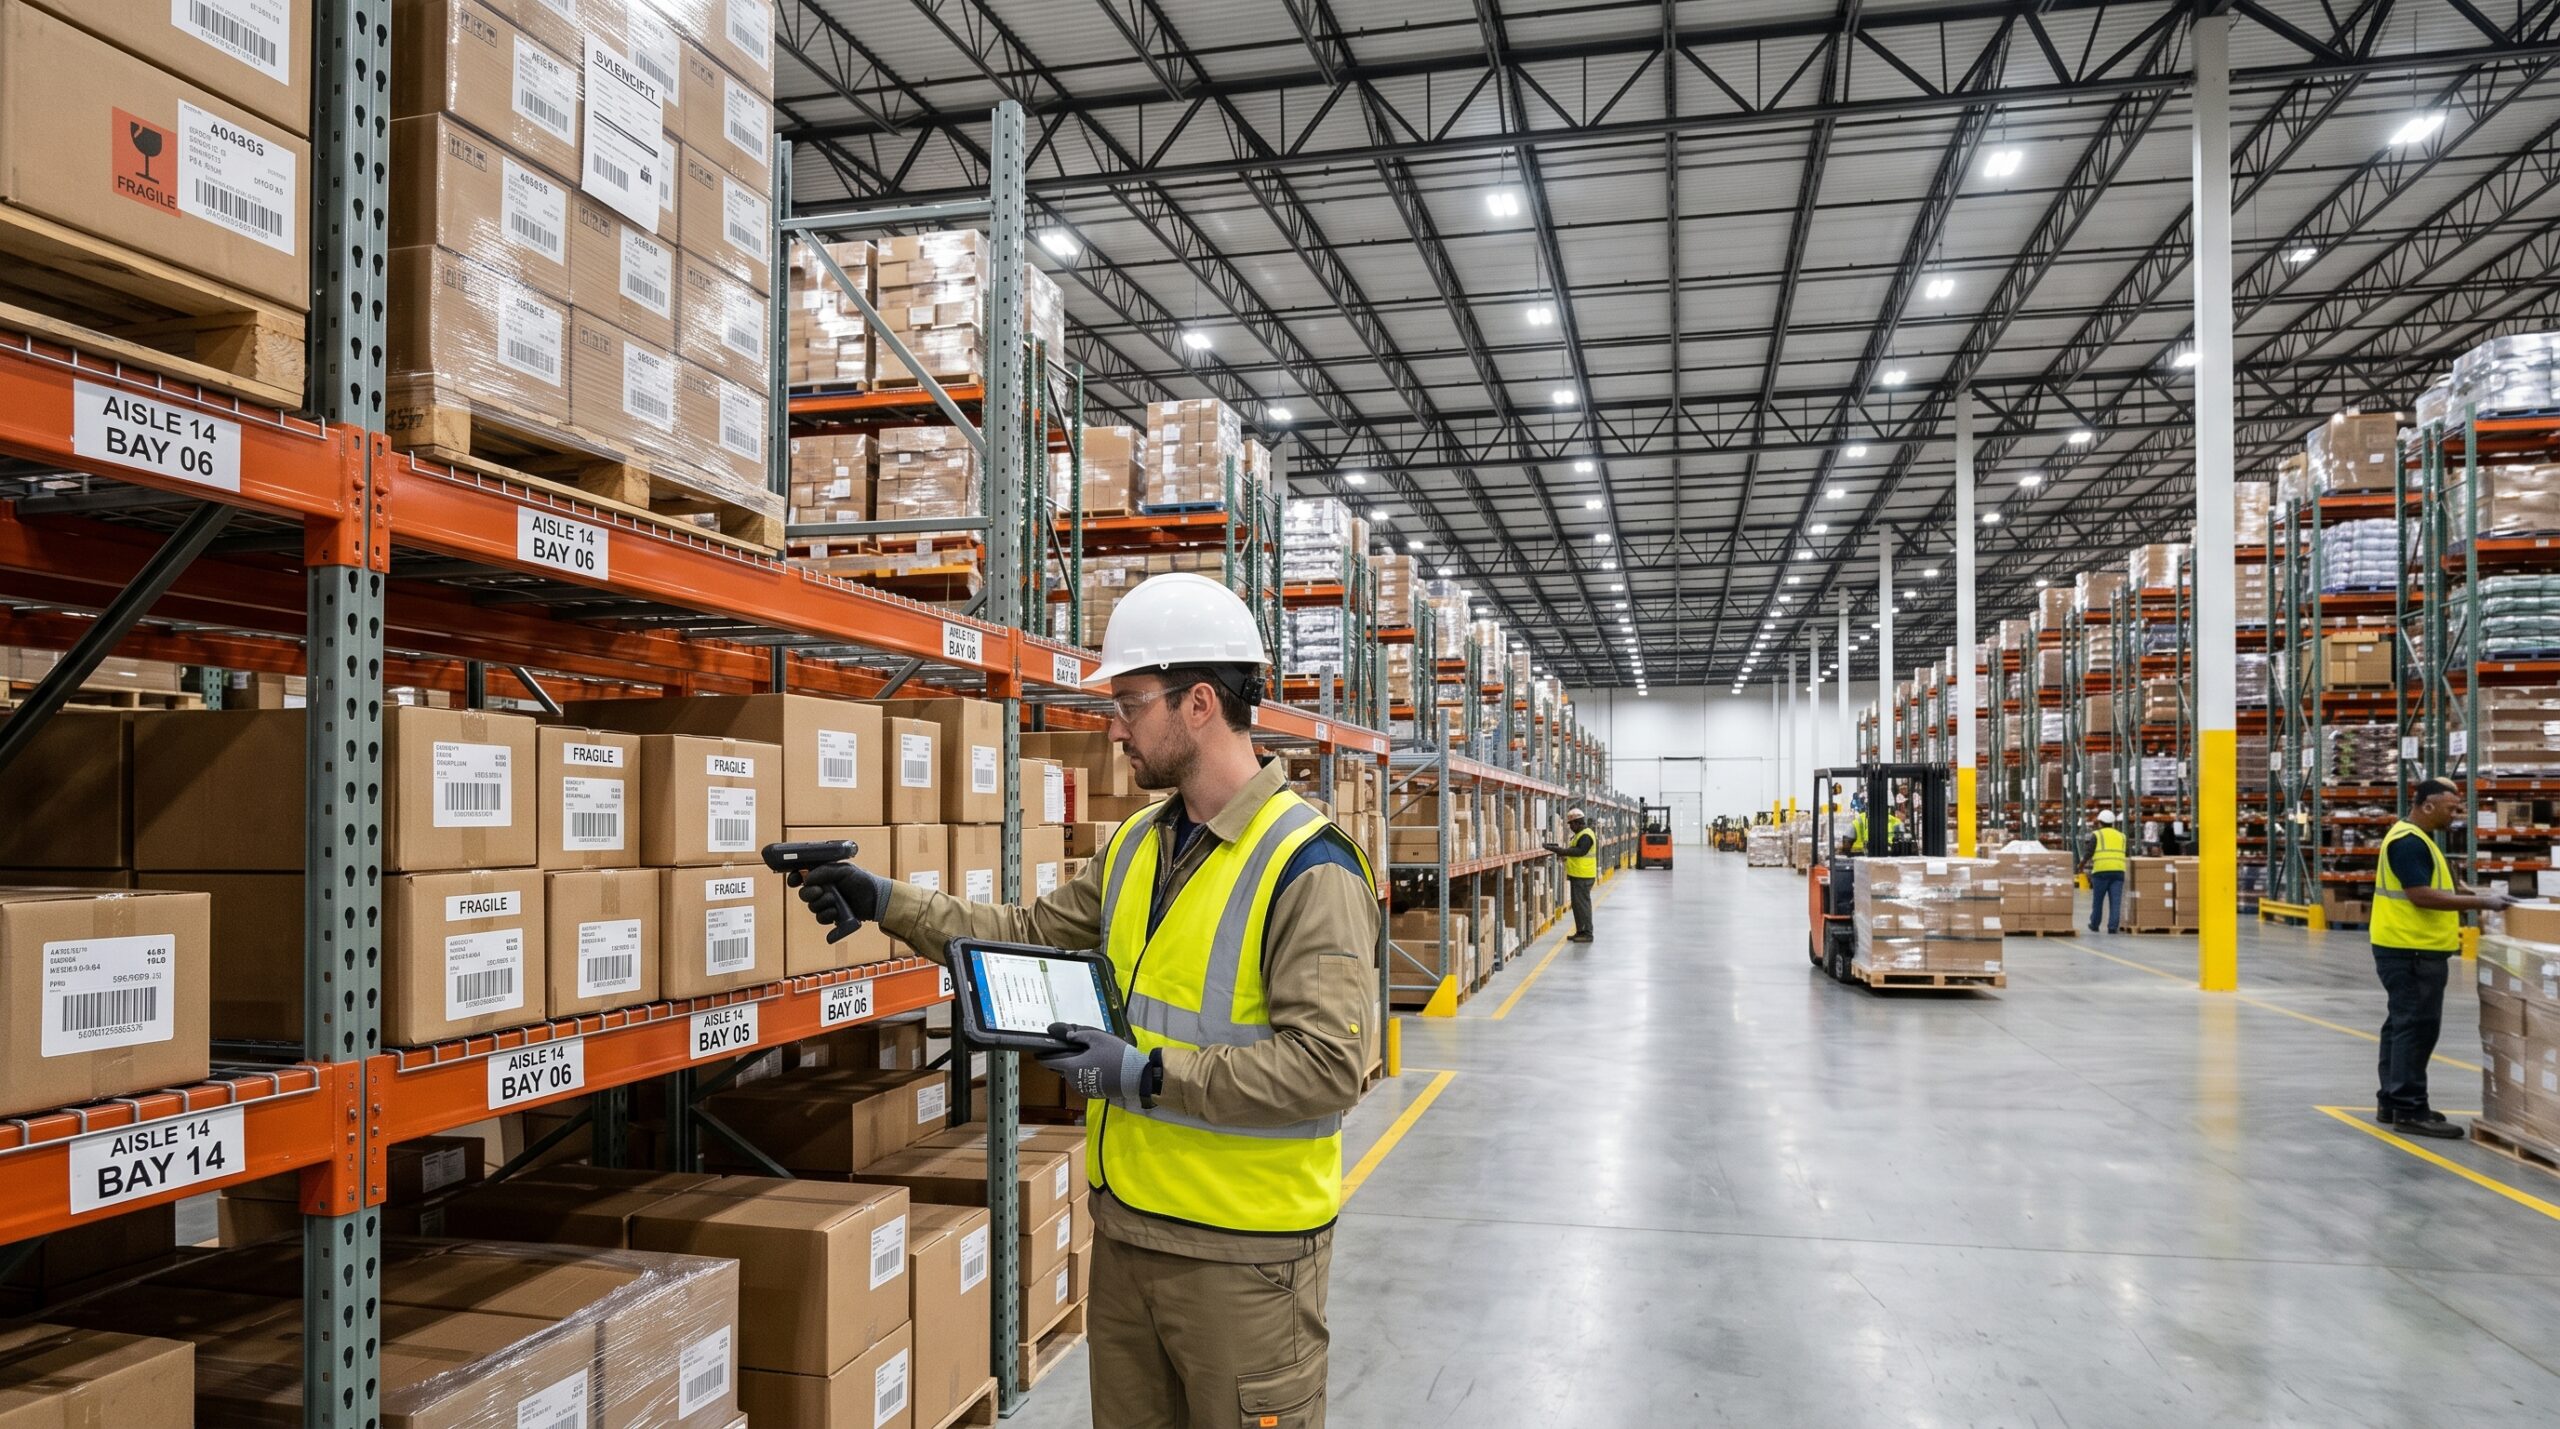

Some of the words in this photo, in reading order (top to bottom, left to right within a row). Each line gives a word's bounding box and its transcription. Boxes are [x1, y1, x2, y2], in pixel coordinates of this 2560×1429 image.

[117, 175, 176, 210] FRAGILE
[103, 396, 182, 435] AISLE
[189, 419, 216, 444] 14
[107, 426, 170, 465] BAY
[180, 446, 213, 476] 06
[532, 516, 575, 541] AISLE
[579, 528, 594, 545] 14
[534, 537, 570, 564] BAY
[575, 548, 594, 570] 06
[949, 640, 966, 657] BAY
[573, 747, 614, 763] FRAGILE
[714, 882, 746, 895] FRAGILE
[459, 897, 507, 915] FRAGILE
[704, 1011, 730, 1027] AISLE
[733, 1009, 743, 1021] 14
[828, 1000, 852, 1020] BAY
[854, 997, 867, 1014] 06
[699, 1027, 729, 1051] BAY
[733, 1023, 750, 1043] 05
[508, 1049, 547, 1071] AISLE
[550, 1046, 564, 1061] 14
[502, 1069, 544, 1100] BAY
[550, 1063, 572, 1087] 06
[110, 1126, 178, 1157] AISLE
[186, 1119, 210, 1139] 14
[98, 1152, 175, 1199] BAY
[186, 1141, 225, 1175] 14
